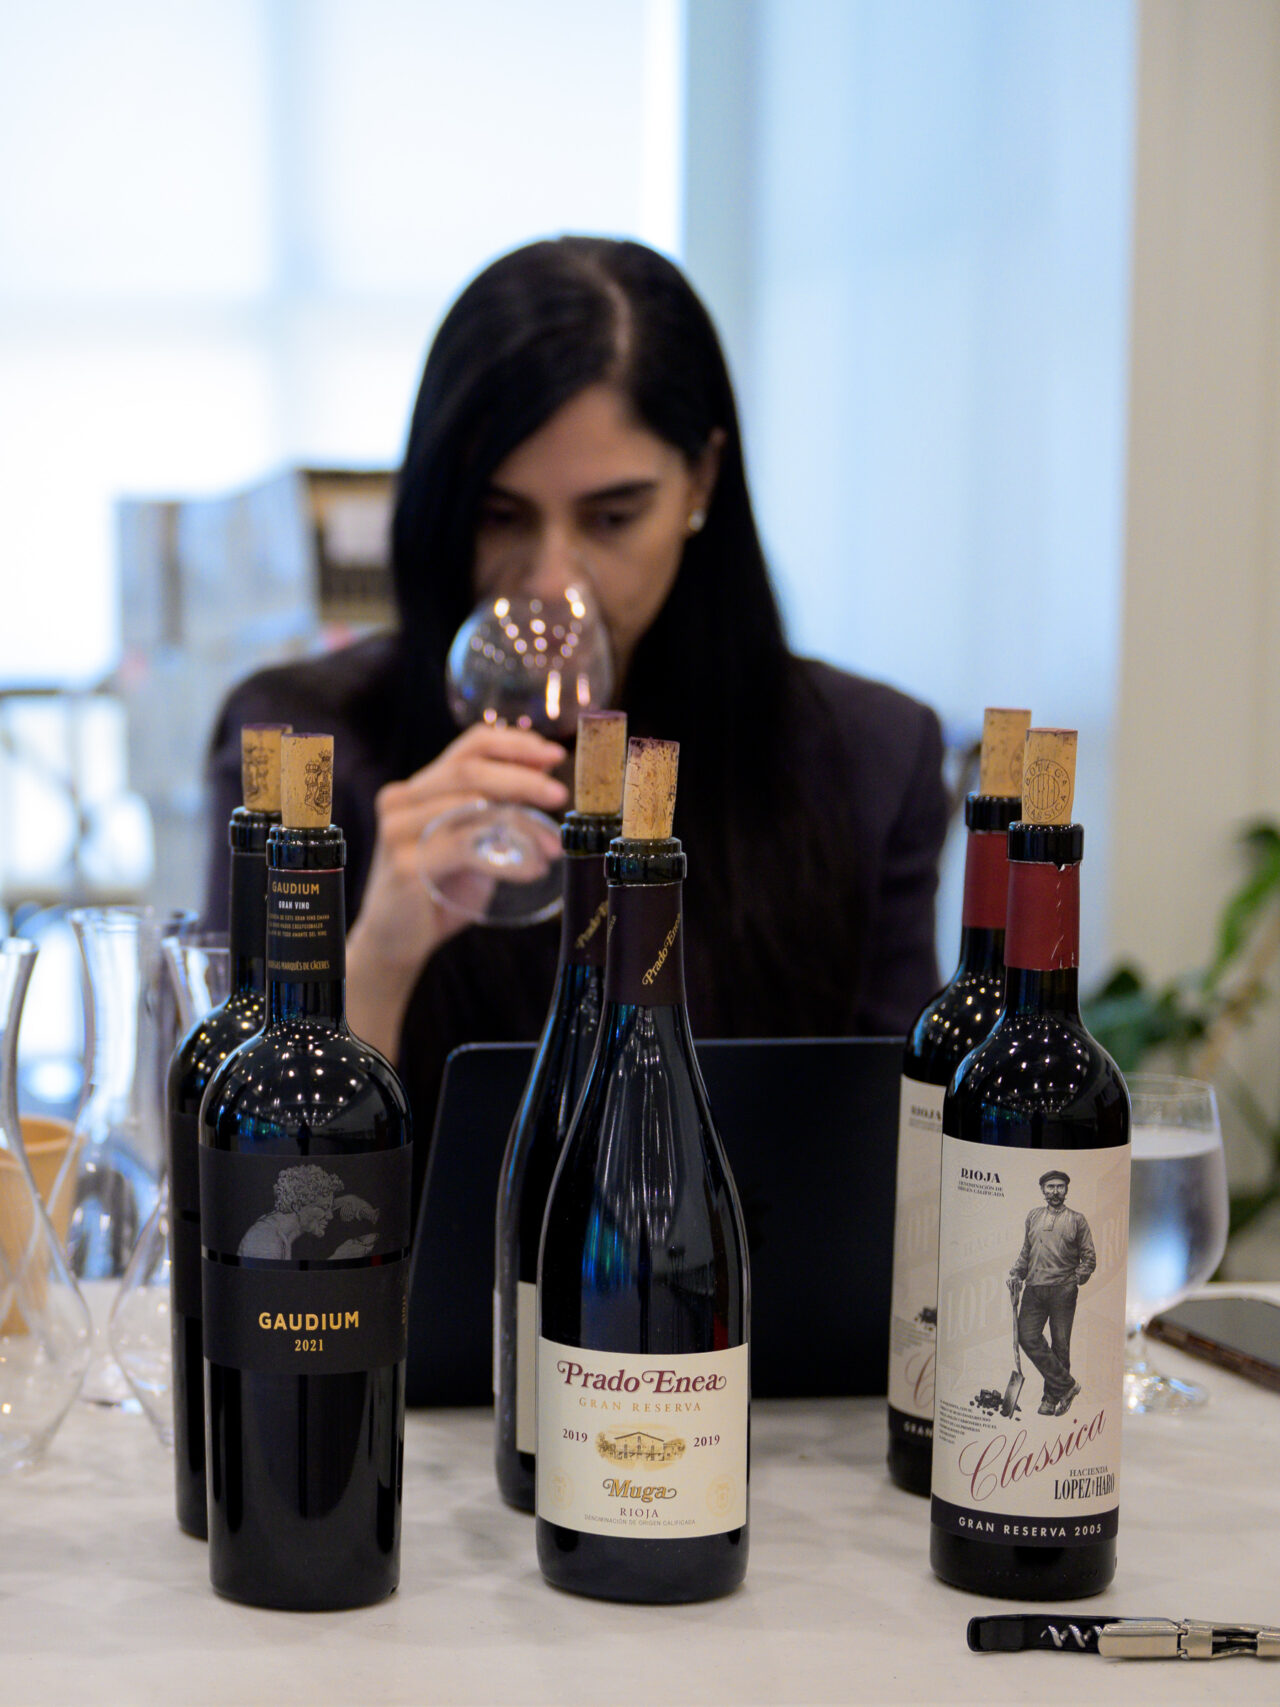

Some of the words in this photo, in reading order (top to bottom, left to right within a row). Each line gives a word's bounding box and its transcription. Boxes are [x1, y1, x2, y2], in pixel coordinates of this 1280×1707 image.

[272, 881, 320, 895] GAUDIUM
[278, 900, 293, 909] GRAN
[294, 901, 310, 910] VINO
[642, 945, 669, 986] Prado
[961, 1168, 1001, 1183] RIOJA
[258, 1311, 360, 1331] GAUDIUM
[294, 1339, 324, 1352] 2021
[557, 1360, 641, 1393] Prado
[641, 1370, 727, 1394] Enea
[578, 1396, 622, 1410] GRAN
[632, 1402, 702, 1413] RESERVA
[562, 1428, 588, 1443] 2019
[693, 1434, 720, 1447] 2019
[958, 1409, 1107, 1501] Classica
[1070, 1465, 1108, 1477] HACIENDA
[602, 1478, 677, 1503] Muga
[1095, 1473, 1115, 1497] HARO
[620, 1507, 659, 1520] RIOJA
[958, 1516, 995, 1533] GRAN
[1003, 1524, 1066, 1537] RESERVA
[1074, 1523, 1102, 1536] 2005
